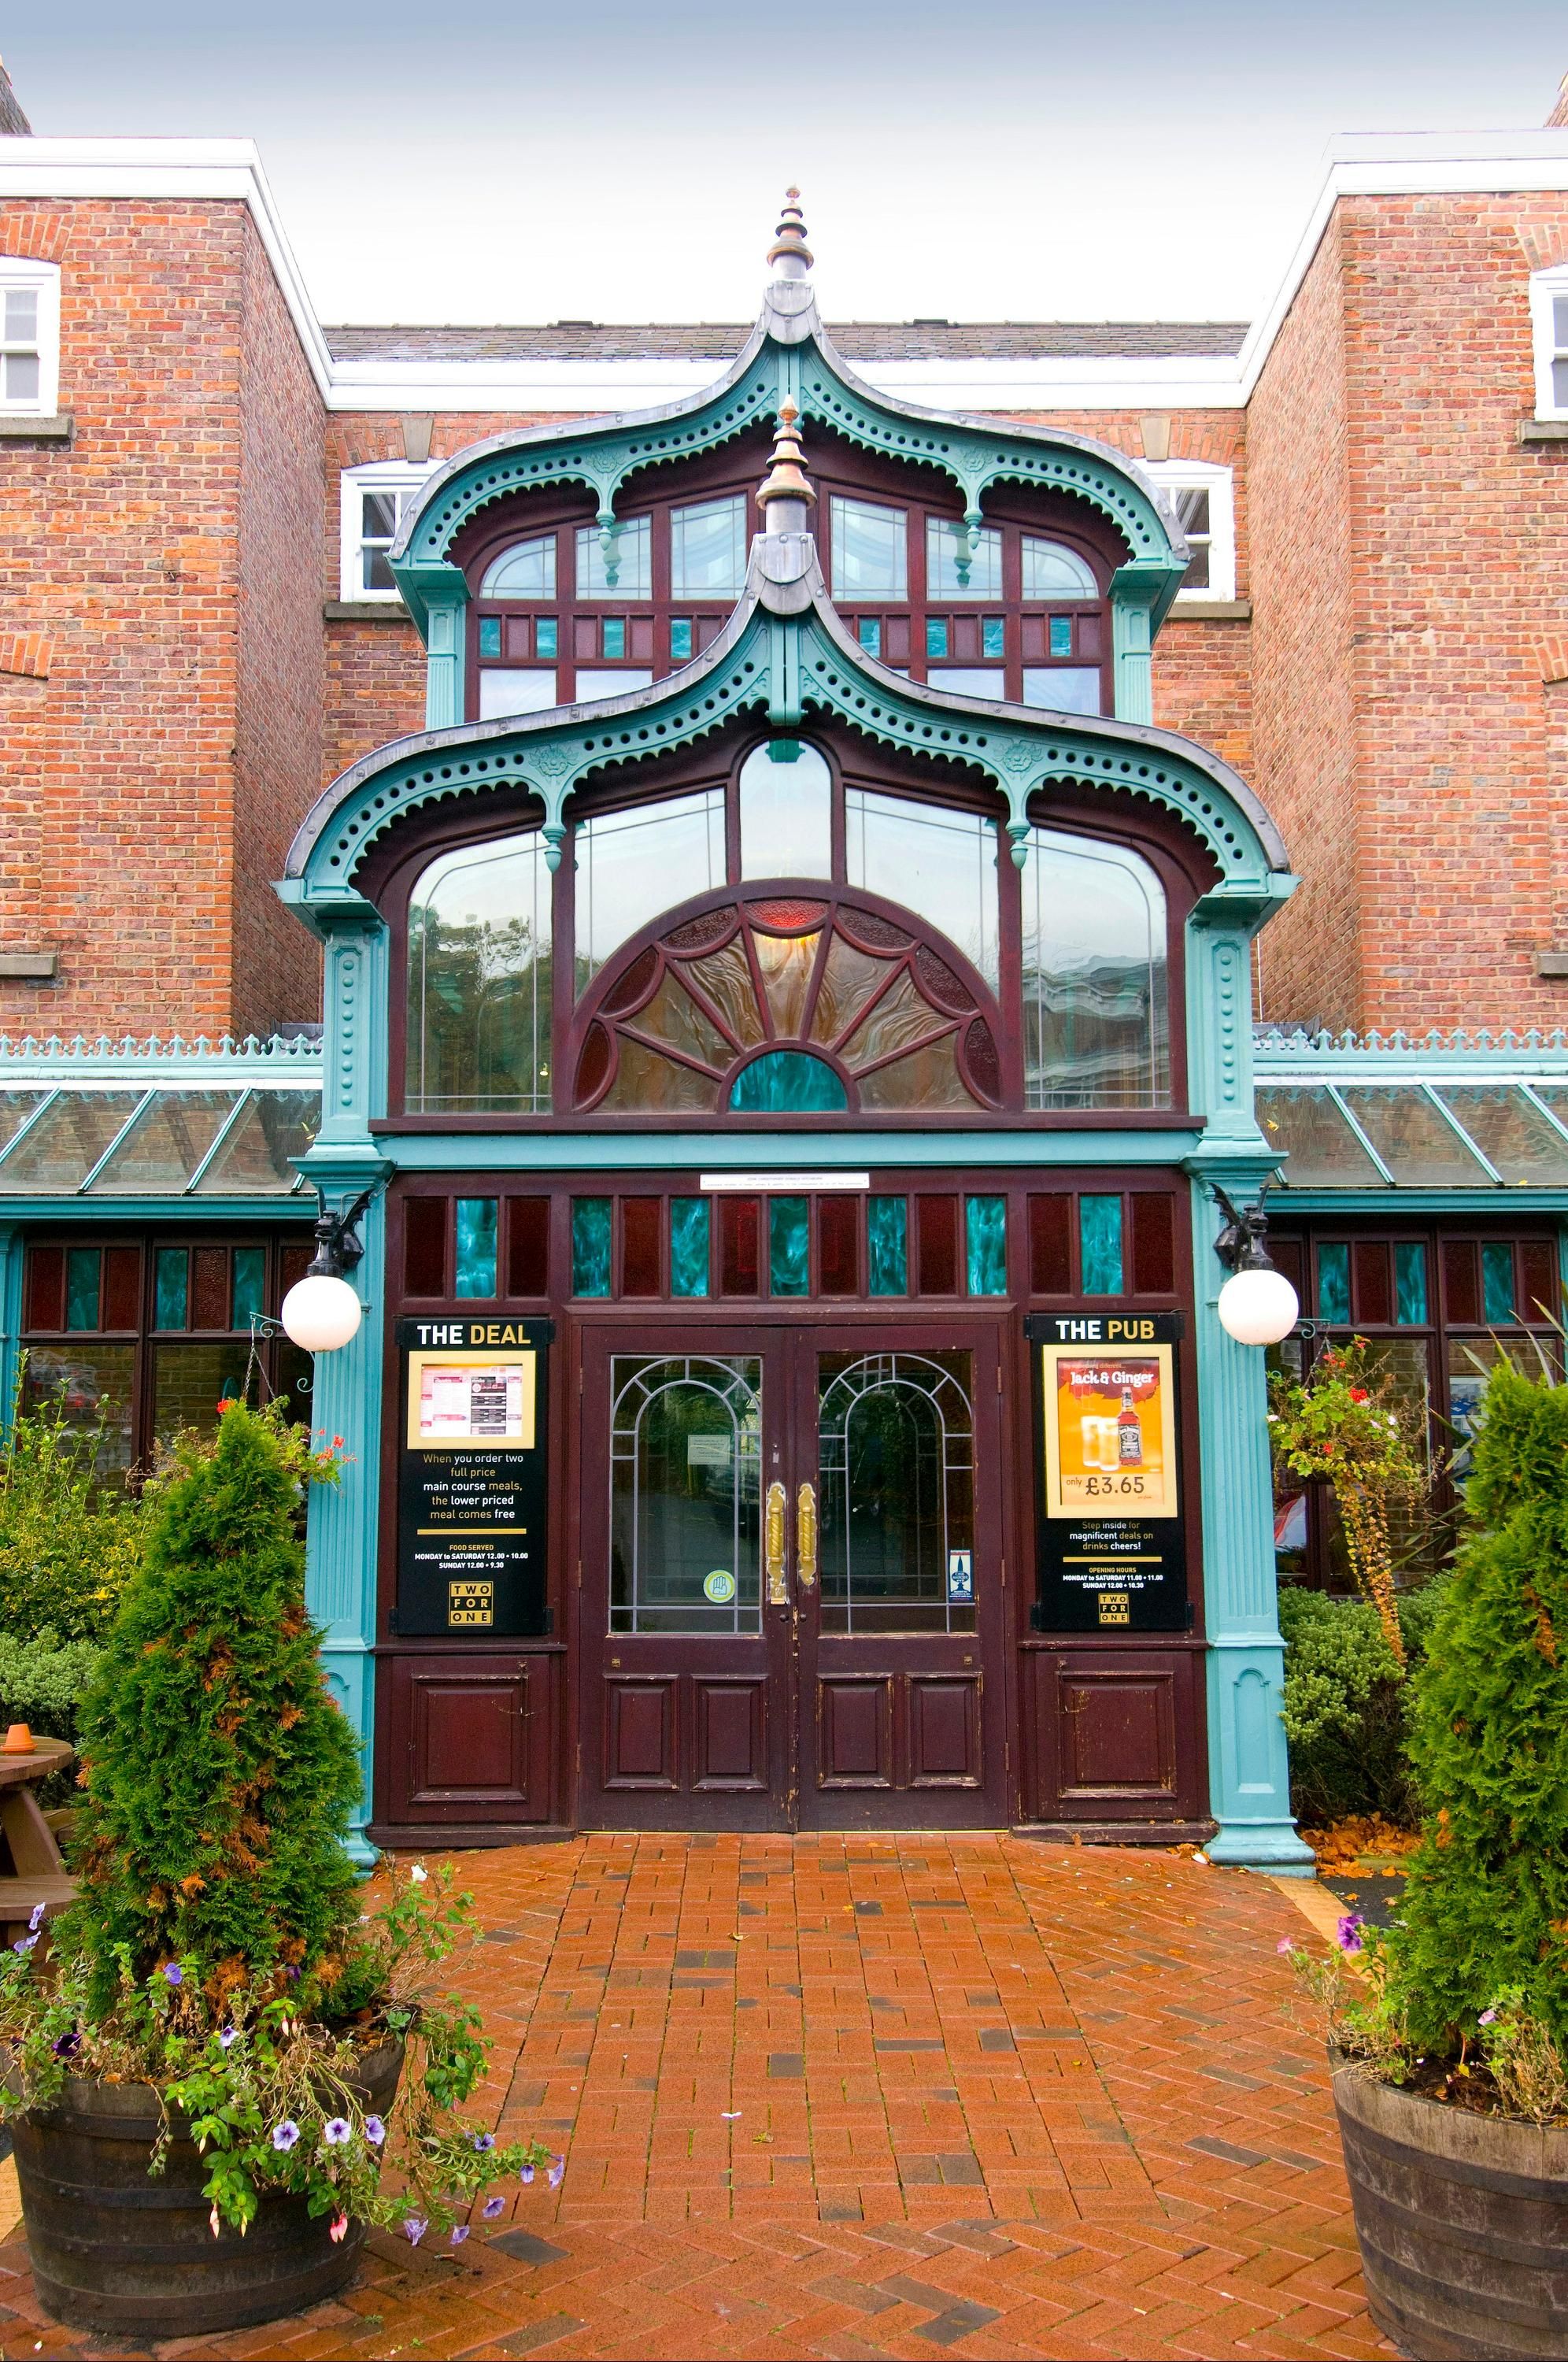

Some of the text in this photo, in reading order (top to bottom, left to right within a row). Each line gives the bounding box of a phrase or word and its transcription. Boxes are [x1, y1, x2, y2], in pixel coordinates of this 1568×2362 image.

[416, 1324, 531, 1345] THE DEAL
[1056, 1320, 1155, 1340] THE PUB
[1071, 1371, 1153, 1387] Jack & Ginger
[423, 1454, 451, 1463] When
[454, 1455, 472, 1465] you
[475, 1453, 501, 1462] order
[451, 1468, 496, 1479] full price
[423, 1482, 449, 1490] main
[489, 1482, 523, 1491] meals,
[1066, 1476, 1145, 1495] only £3.65
[431, 1496, 513, 1507] the lower priced
[430, 1510, 456, 1519] meal
[494, 1509, 515, 1518] free
[1070, 1531, 1117, 1542] magnificent
[454, 1586, 489, 1594] TWO
[454, 1598, 488, 1608] FOR
[453, 1612, 487, 1621] ONE
